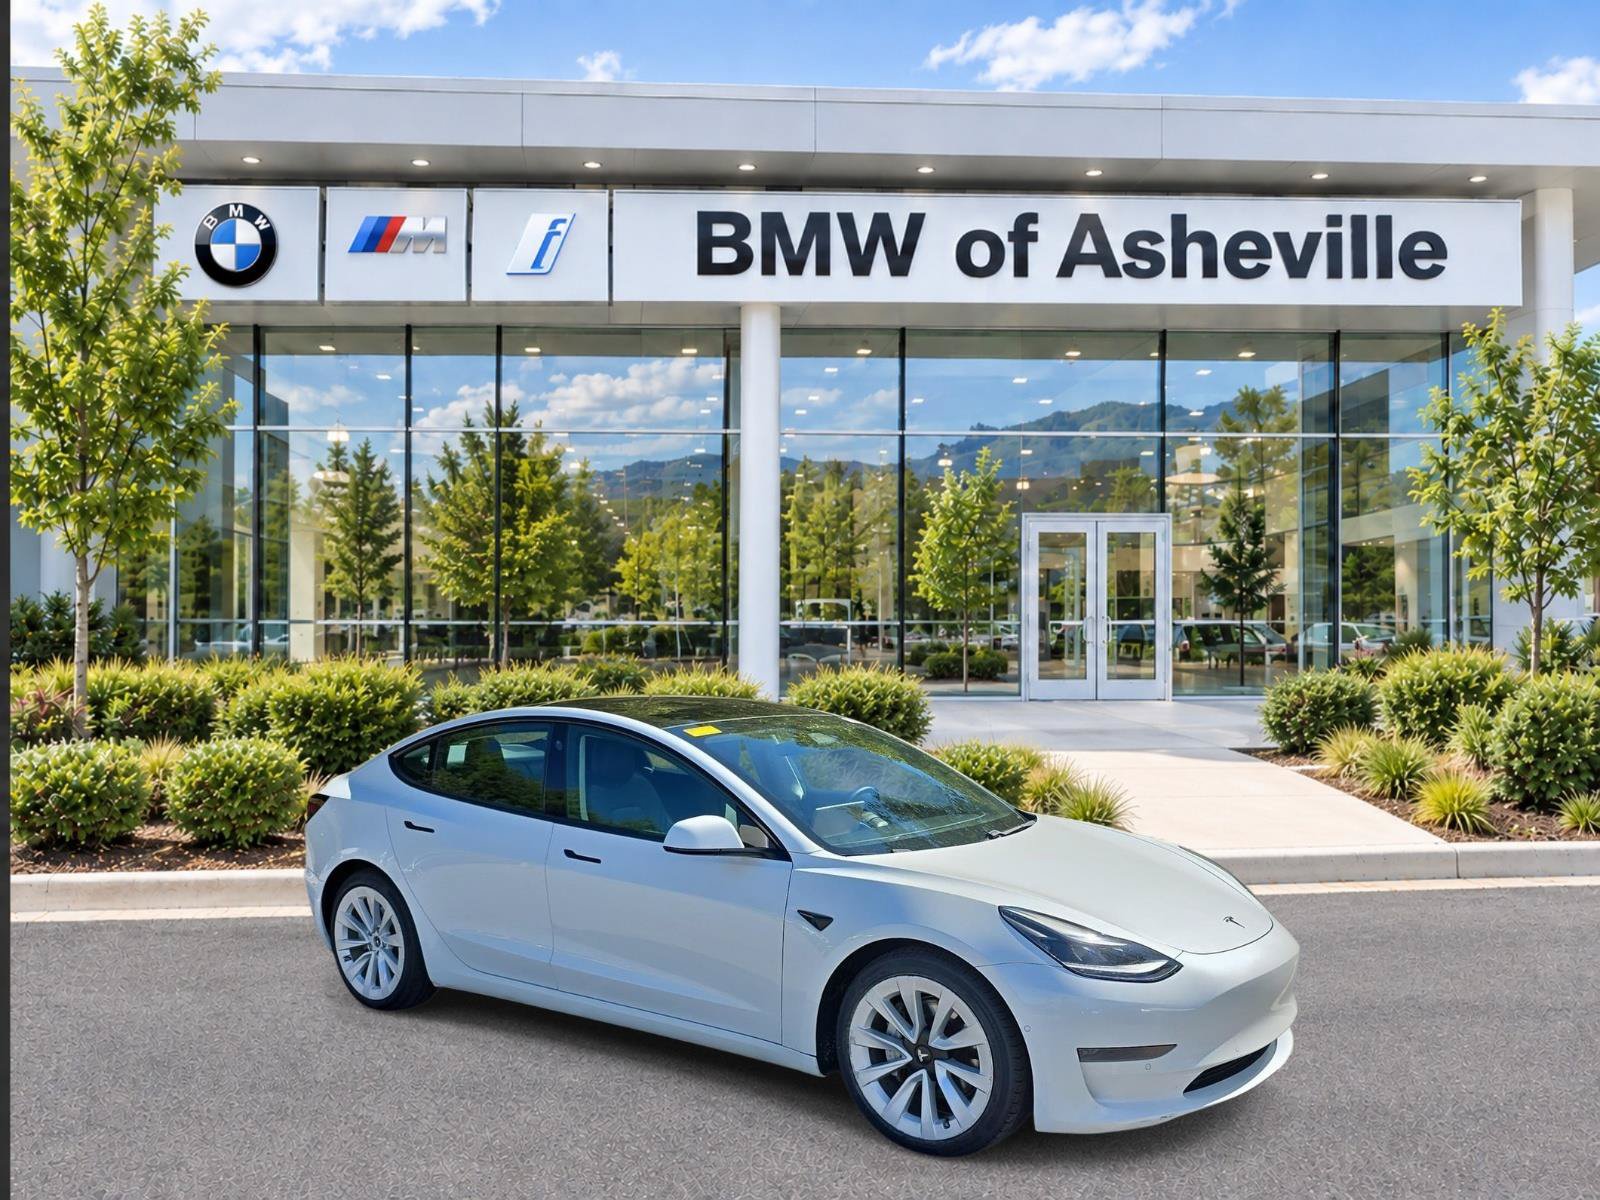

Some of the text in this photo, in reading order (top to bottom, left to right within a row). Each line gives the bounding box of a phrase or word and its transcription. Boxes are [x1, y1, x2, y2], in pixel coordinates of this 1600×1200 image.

[202, 204, 271, 231] BMW
[696, 210, 1448, 281] BMW of Asheville
